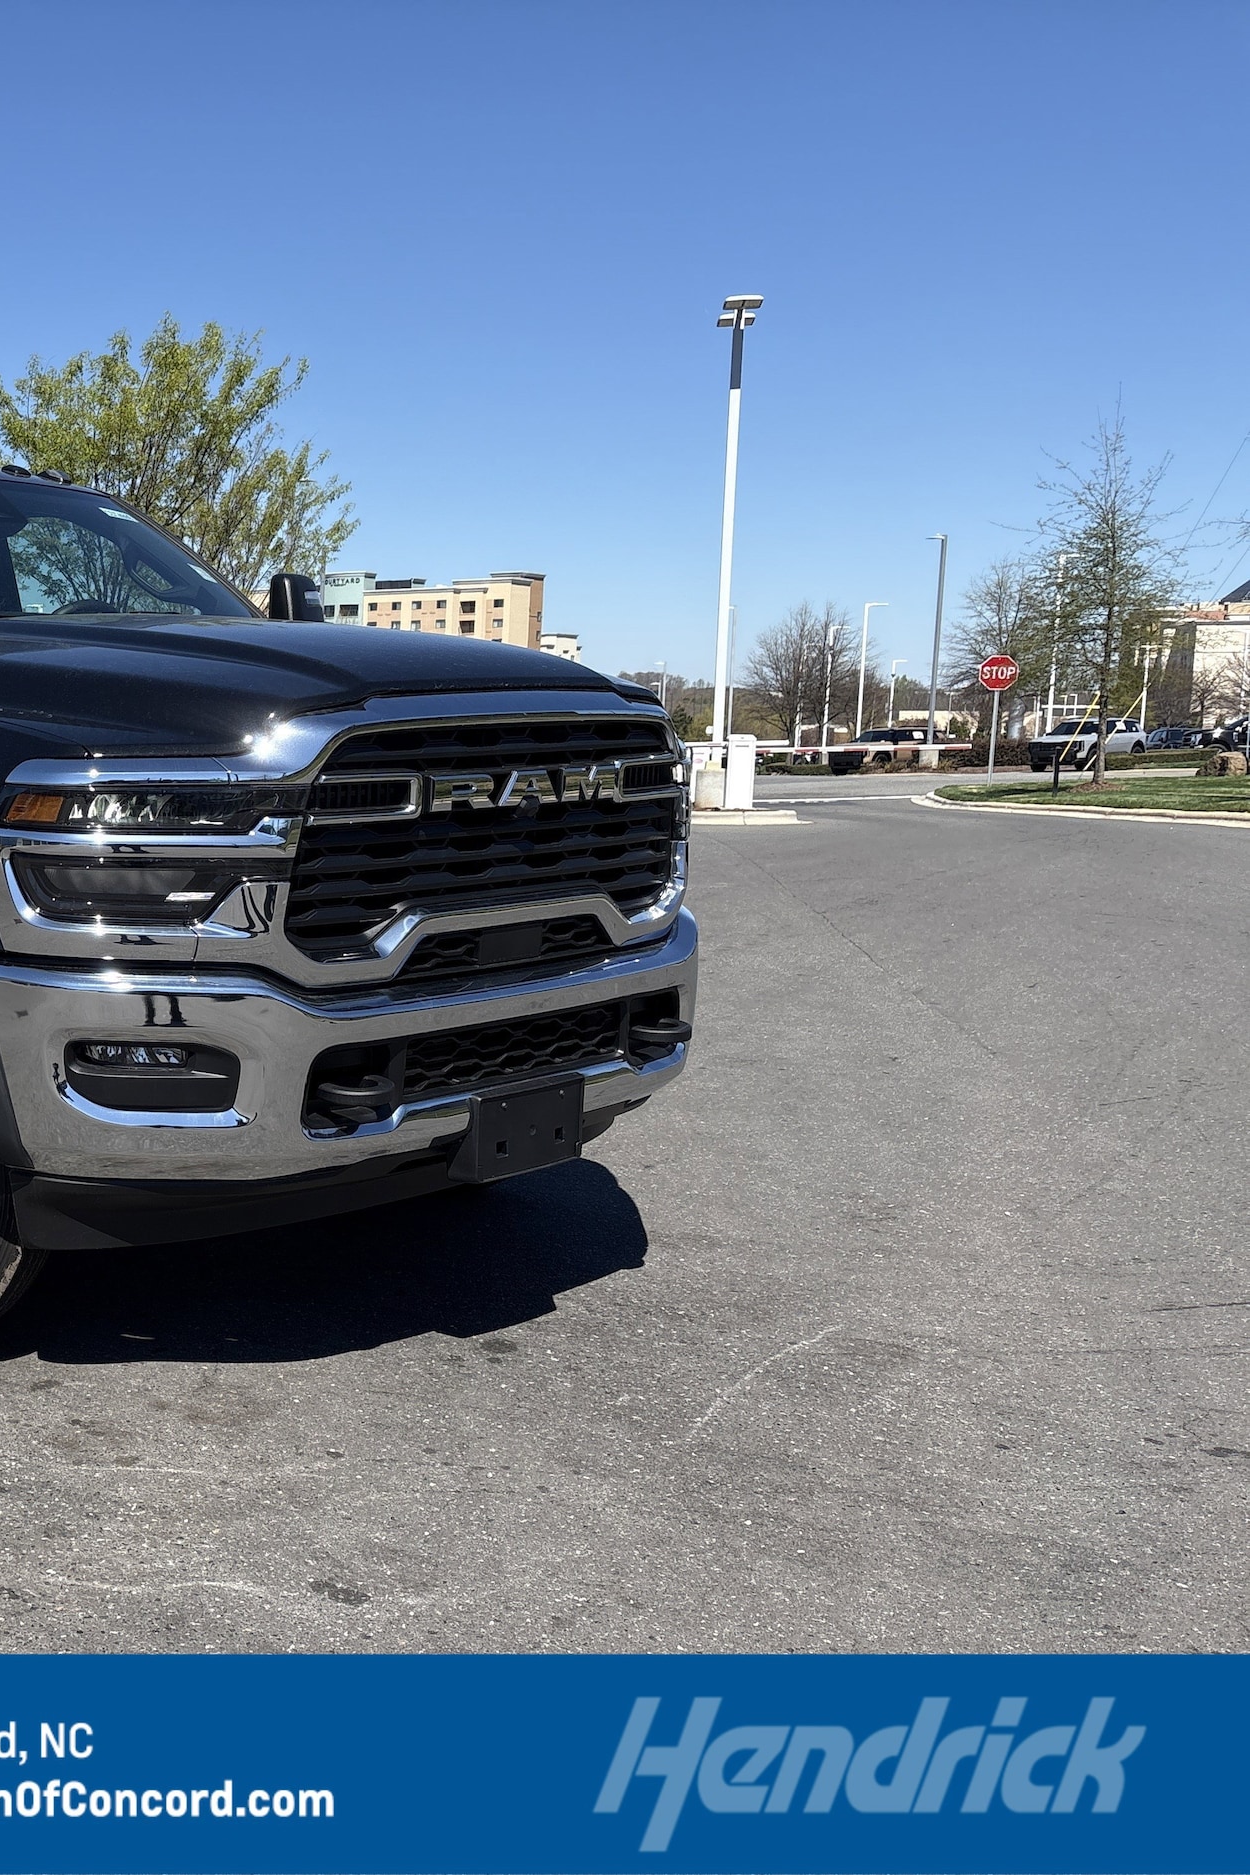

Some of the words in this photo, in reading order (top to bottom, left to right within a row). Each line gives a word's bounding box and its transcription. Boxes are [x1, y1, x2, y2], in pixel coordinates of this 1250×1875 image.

[322, 577, 361, 585] OURTYARD
[982, 666, 1016, 680] STOP
[430, 765, 616, 812] RAM
